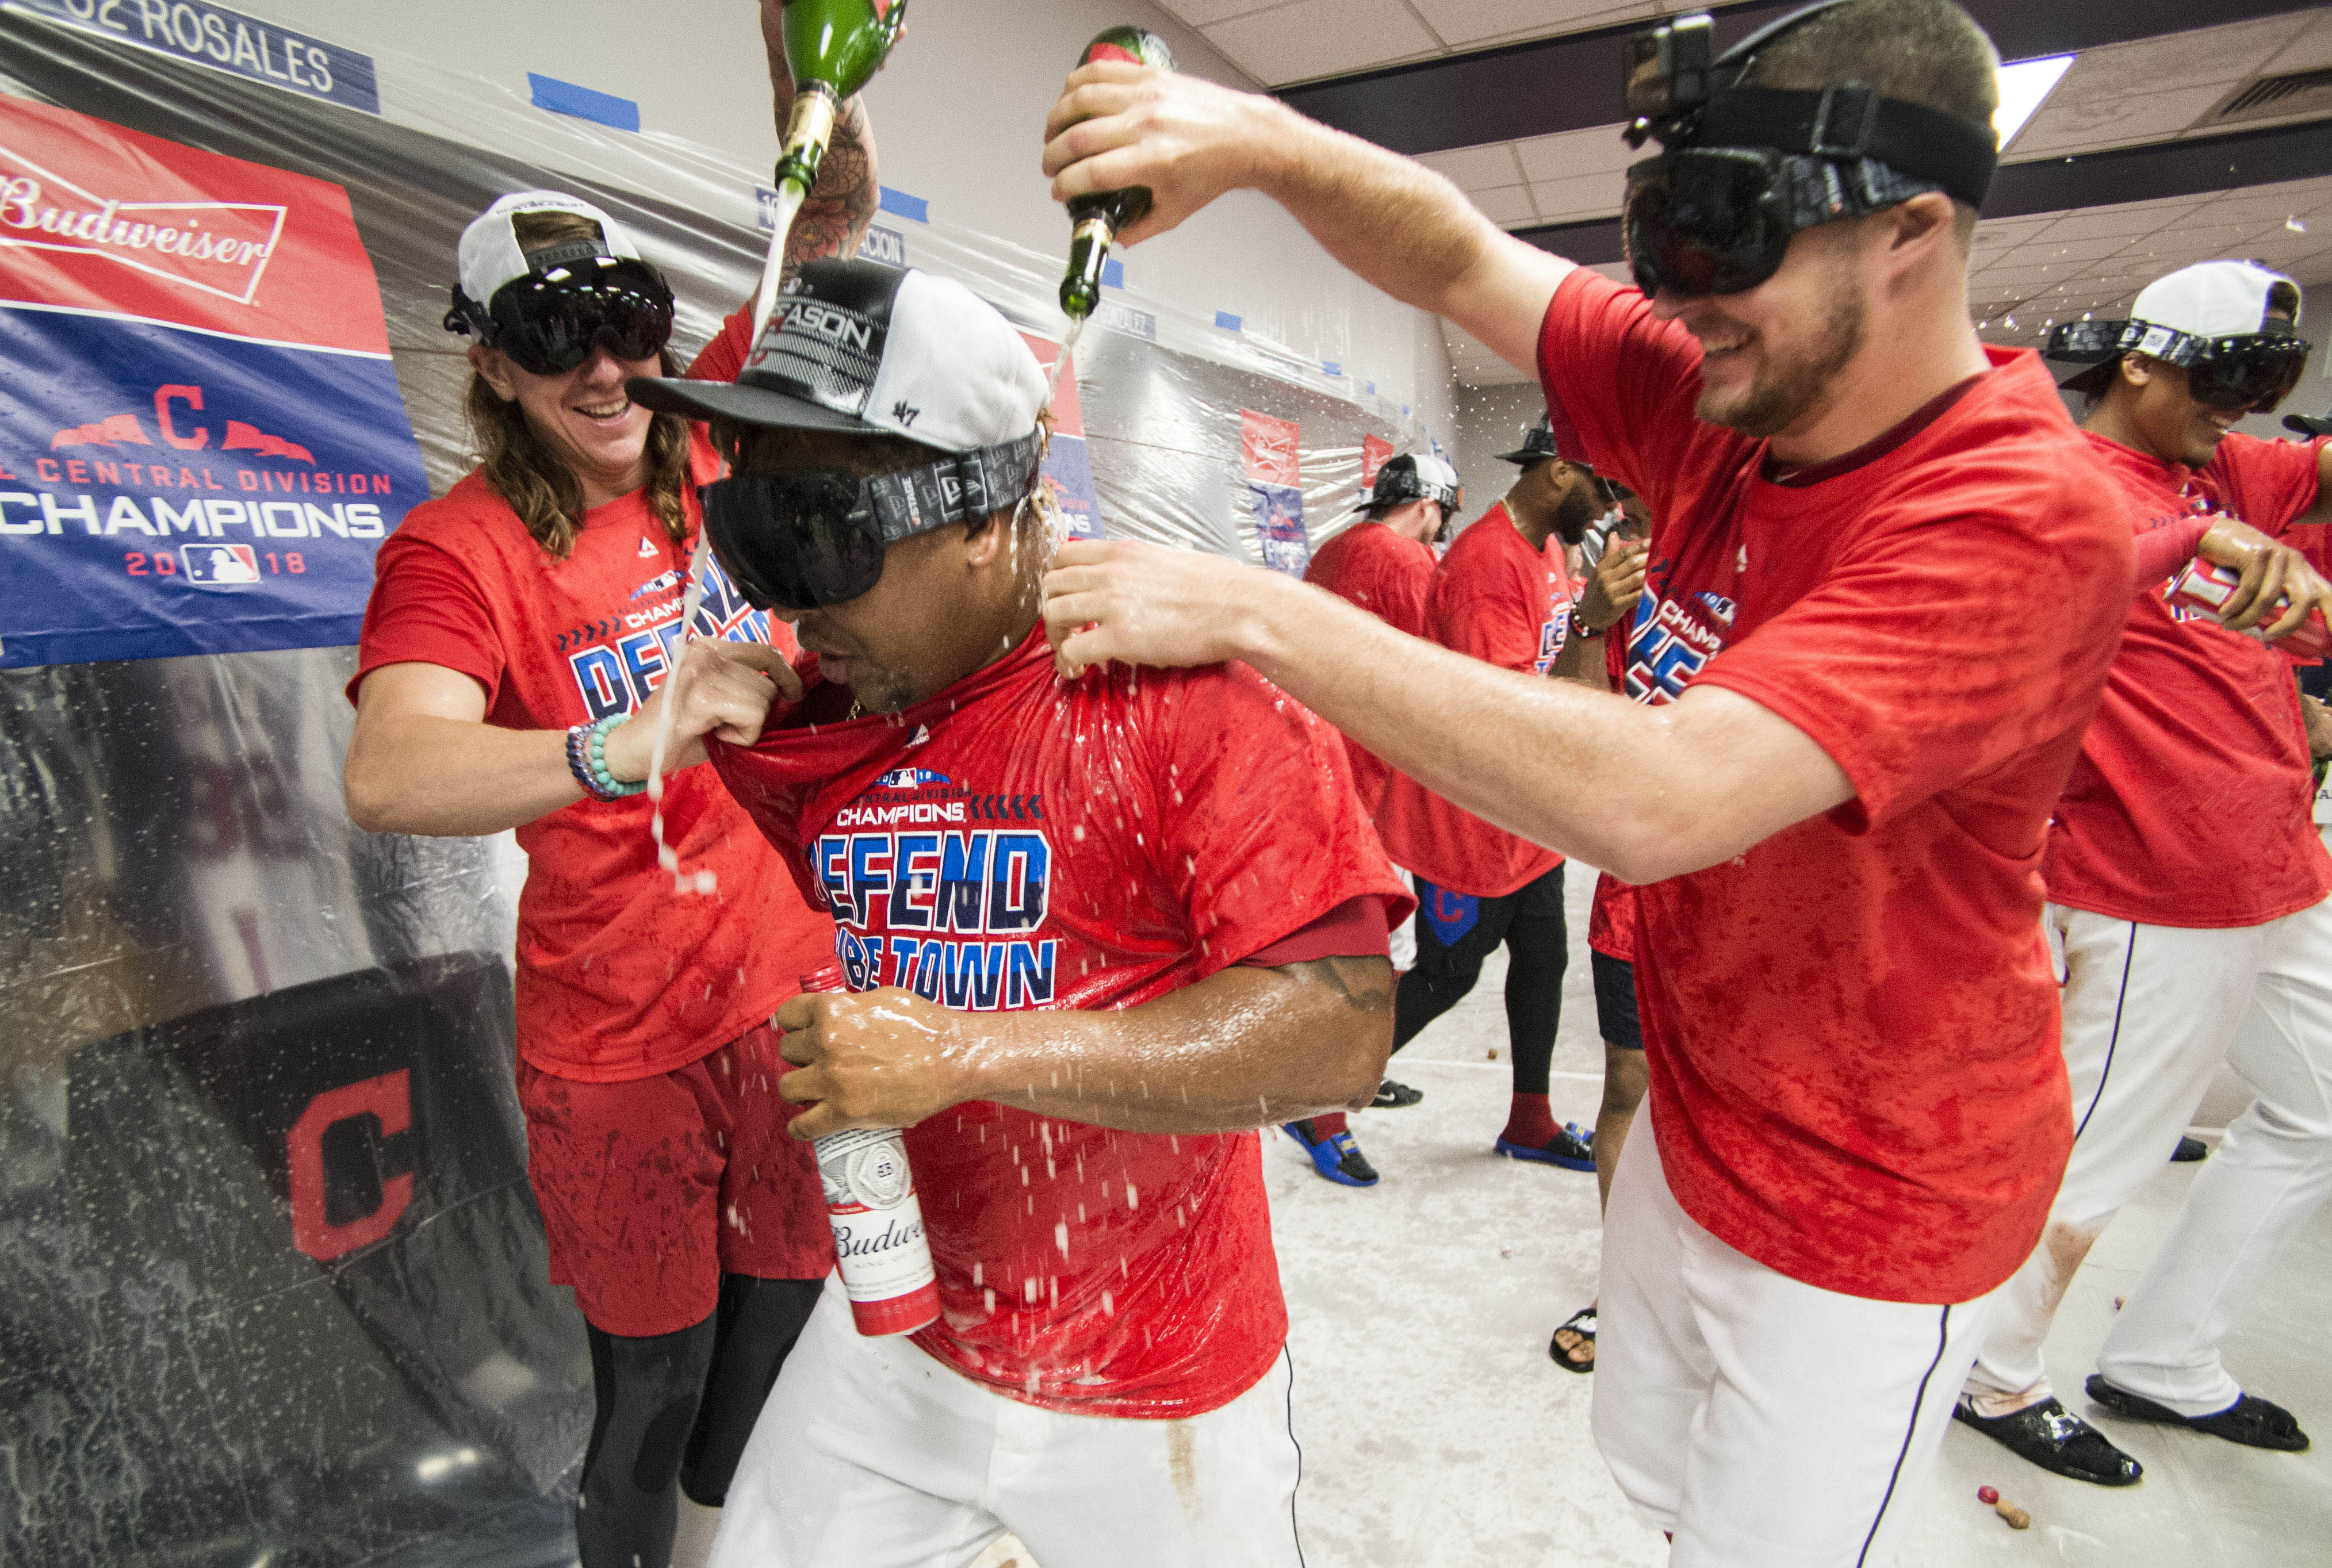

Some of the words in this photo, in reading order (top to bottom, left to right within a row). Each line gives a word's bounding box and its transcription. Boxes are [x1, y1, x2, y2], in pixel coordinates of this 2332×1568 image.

[140, 0, 333, 93] ROSALES
[0, 178, 270, 267] Budweiser
[36, 458, 223, 490] CENTRAL
[238, 470, 392, 494] DIVISION
[0, 492, 385, 538] CHAMPIONS
[125, 551, 177, 576] 20
[266, 552, 306, 574] 18
[625, 596, 686, 628] CHAMP
[1660, 599, 1722, 659] CHAMP
[836, 802, 965, 827] CHAMPIONS
[810, 829, 1052, 935] EFEND
[890, 934, 1057, 1011] TOWN
